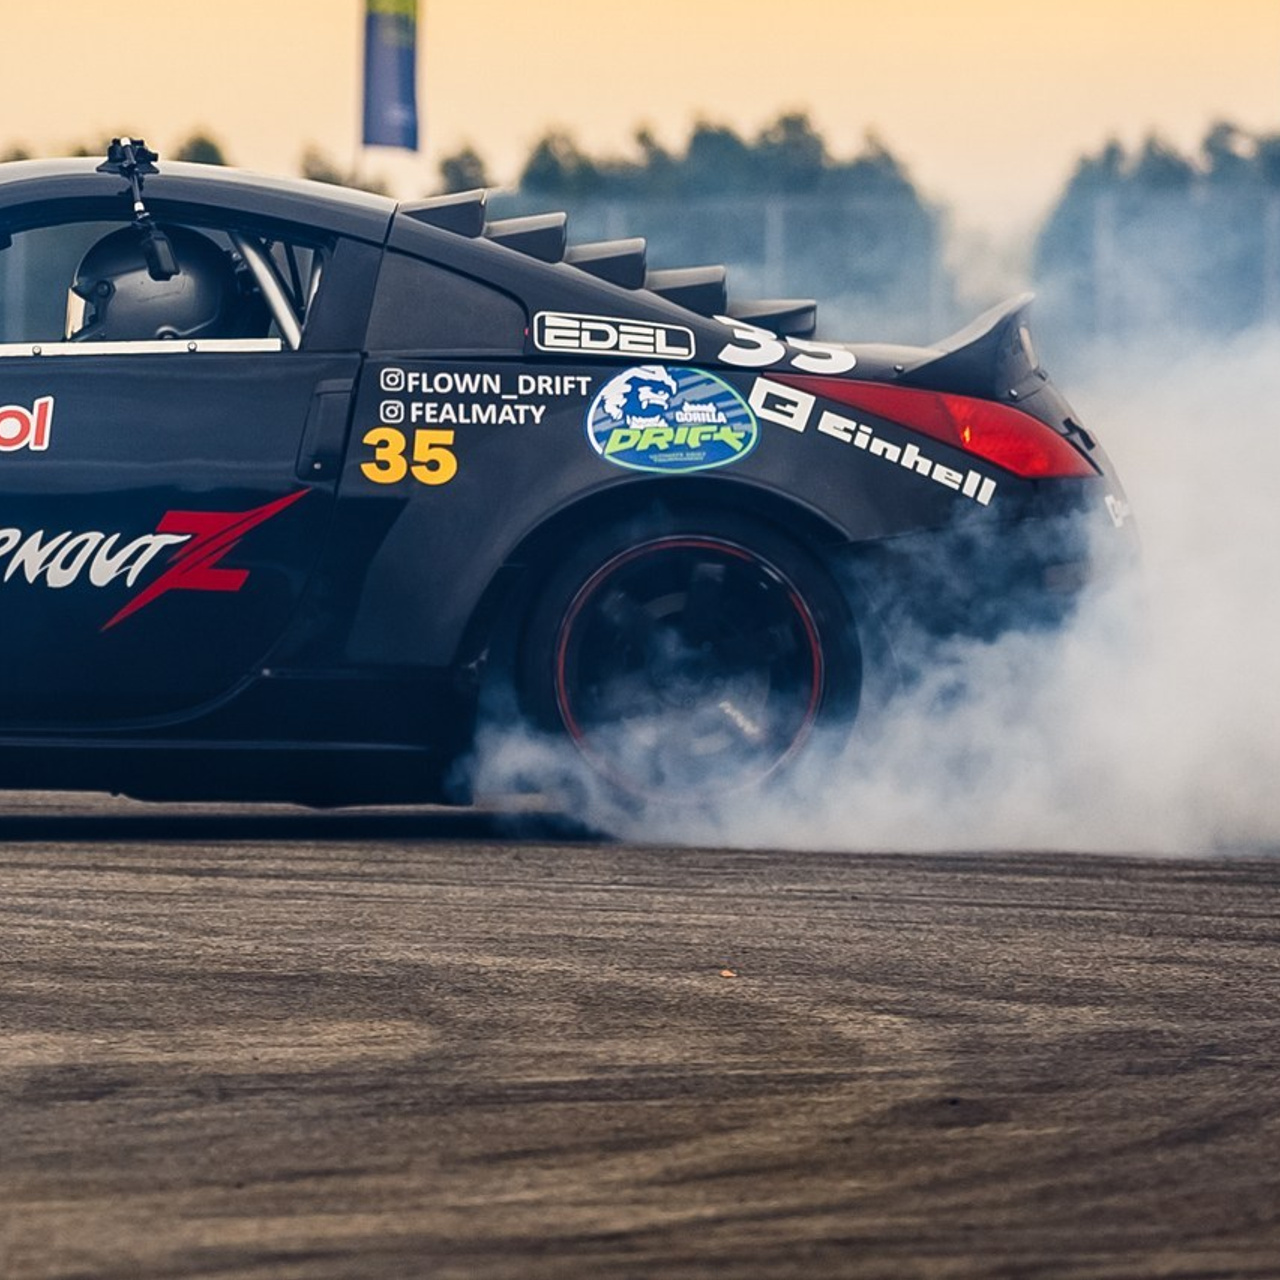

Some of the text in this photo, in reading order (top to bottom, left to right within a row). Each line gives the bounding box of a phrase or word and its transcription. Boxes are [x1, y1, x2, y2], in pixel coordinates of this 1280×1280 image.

[544, 315, 689, 356] EDEL
[406, 372, 593, 401] FLOWN_DRIFT
[410, 402, 547, 425] FEALMATY
[674, 411, 728, 424] GORILLA
[604, 425, 747, 456] DRIFT
[360, 427, 458, 486] 35
[817, 410, 997, 507] Einhell
